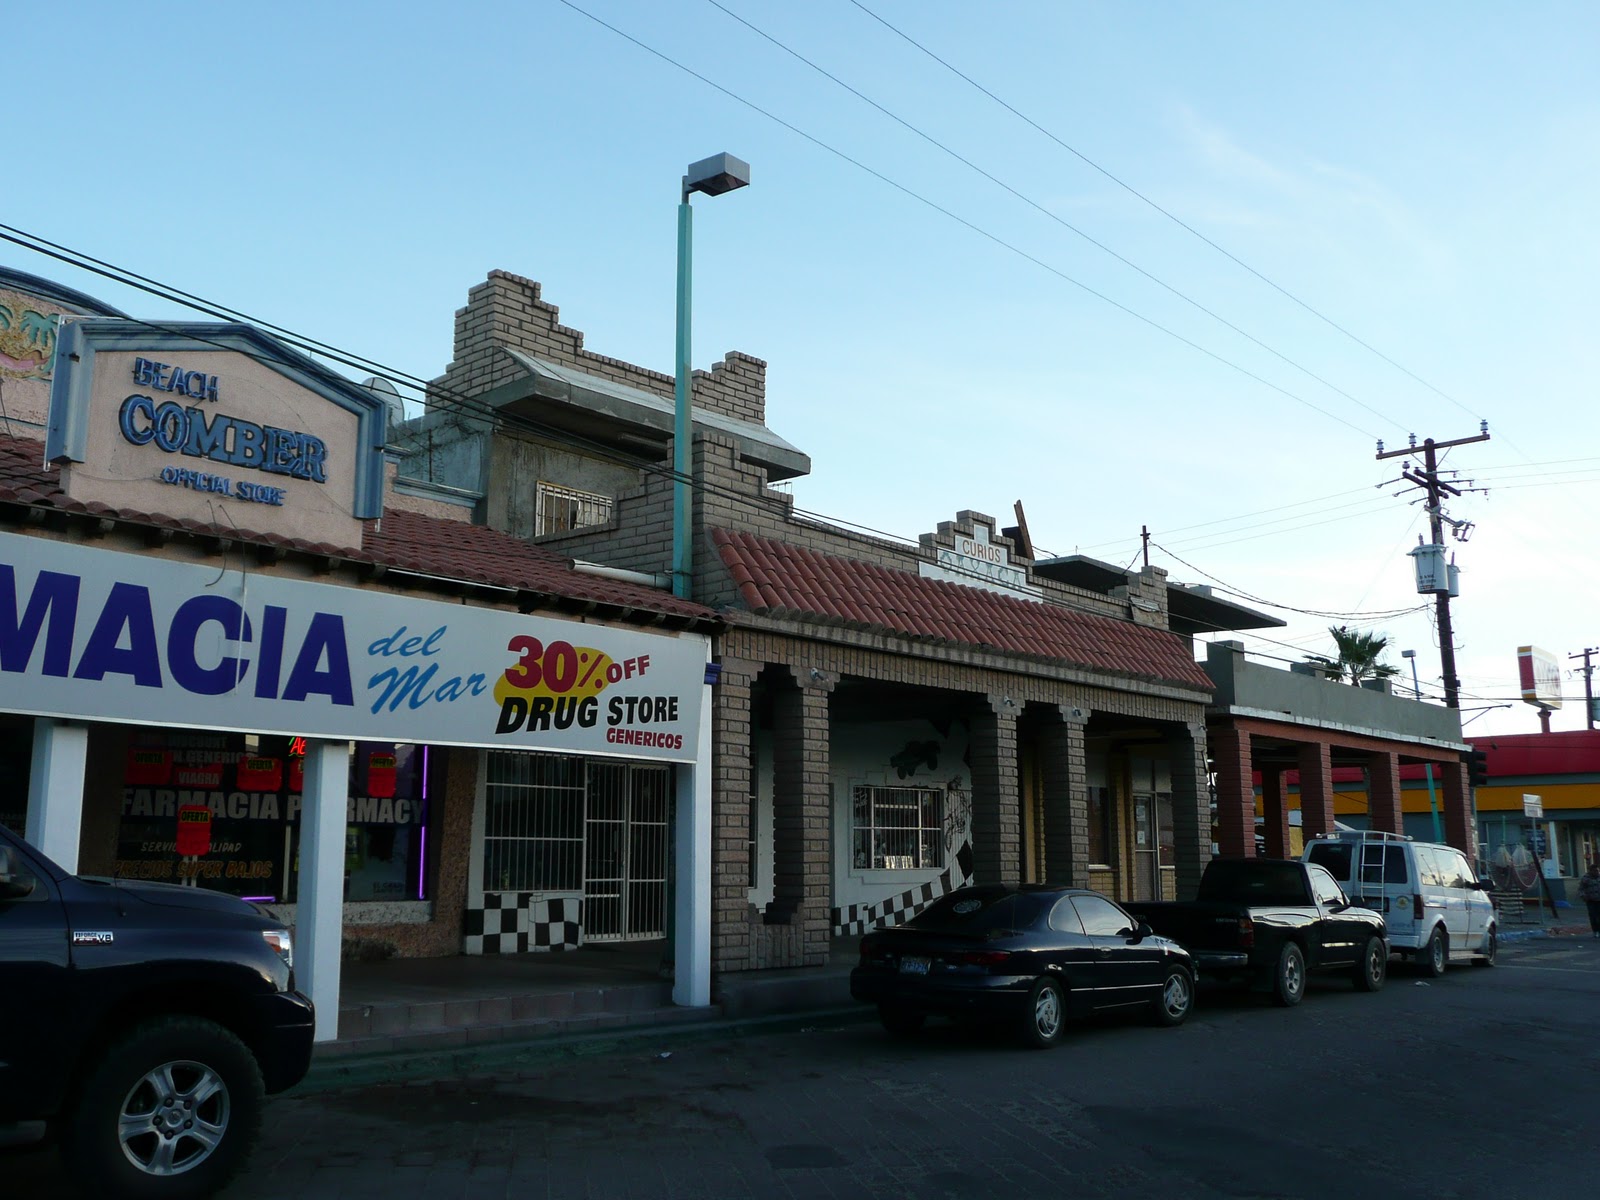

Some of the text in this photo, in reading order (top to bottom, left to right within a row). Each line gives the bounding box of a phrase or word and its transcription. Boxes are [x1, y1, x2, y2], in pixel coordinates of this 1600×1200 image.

[134, 356, 219, 402] BEACH
[119, 393, 328, 484] COMBER
[159, 465, 288, 507] OFFICIAL STORE
[962, 539, 1001, 563] CURIOS
[0, 564, 355, 707] MACIA
[367, 625, 448, 657] del
[505, 634, 651, 694] 30% OFF
[367, 662, 487, 715] Mar
[495, 695, 679, 734] DRUG STORE
[605, 727, 683, 750] GENERICOS
[178, 771, 219, 785] VIAGRA
[247, 758, 273, 770] OFERTA
[181, 810, 209, 823] OFERTA
[287, 796, 424, 824] PRMACY
[113, 860, 273, 879] PRECIOS SUPER BAJOS
[98, 934, 112, 943] V8
